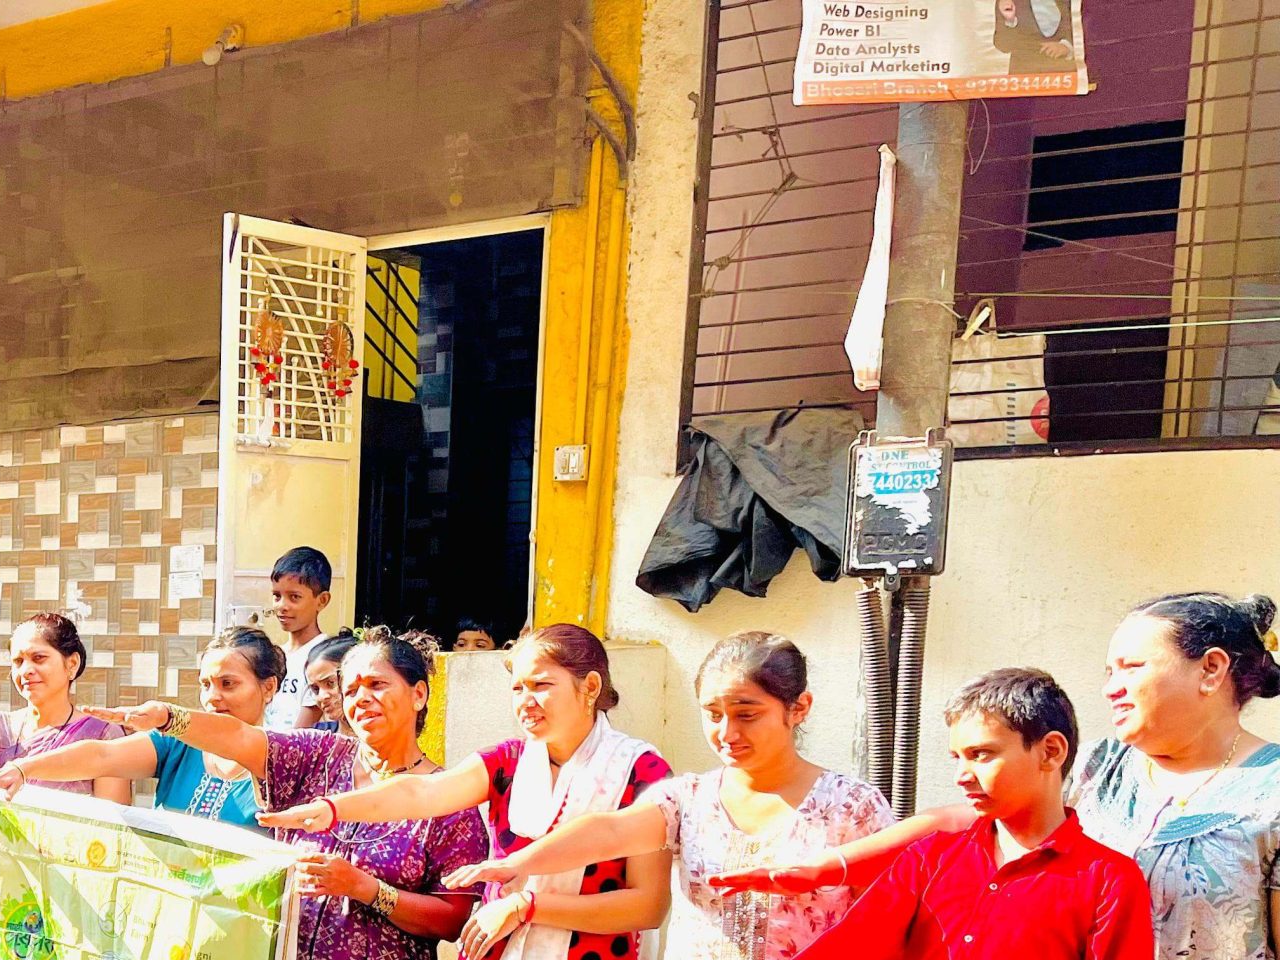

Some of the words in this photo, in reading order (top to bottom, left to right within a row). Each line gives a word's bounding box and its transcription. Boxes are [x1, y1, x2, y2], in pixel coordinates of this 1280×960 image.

[823, 4, 850, 18] Web
[855, 5, 928, 21] Designing
[820, 23, 859, 37] Power
[865, 25, 881, 37] BI
[816, 43, 850, 55] Data
[855, 42, 921, 57] Analysts
[813, 61, 864, 76] Digital
[870, 60, 951, 74] Marketing
[883, 81, 949, 95] Branch
[966, 75, 1072, 92] 9373344445
[194, 952, 212, 960] gni
